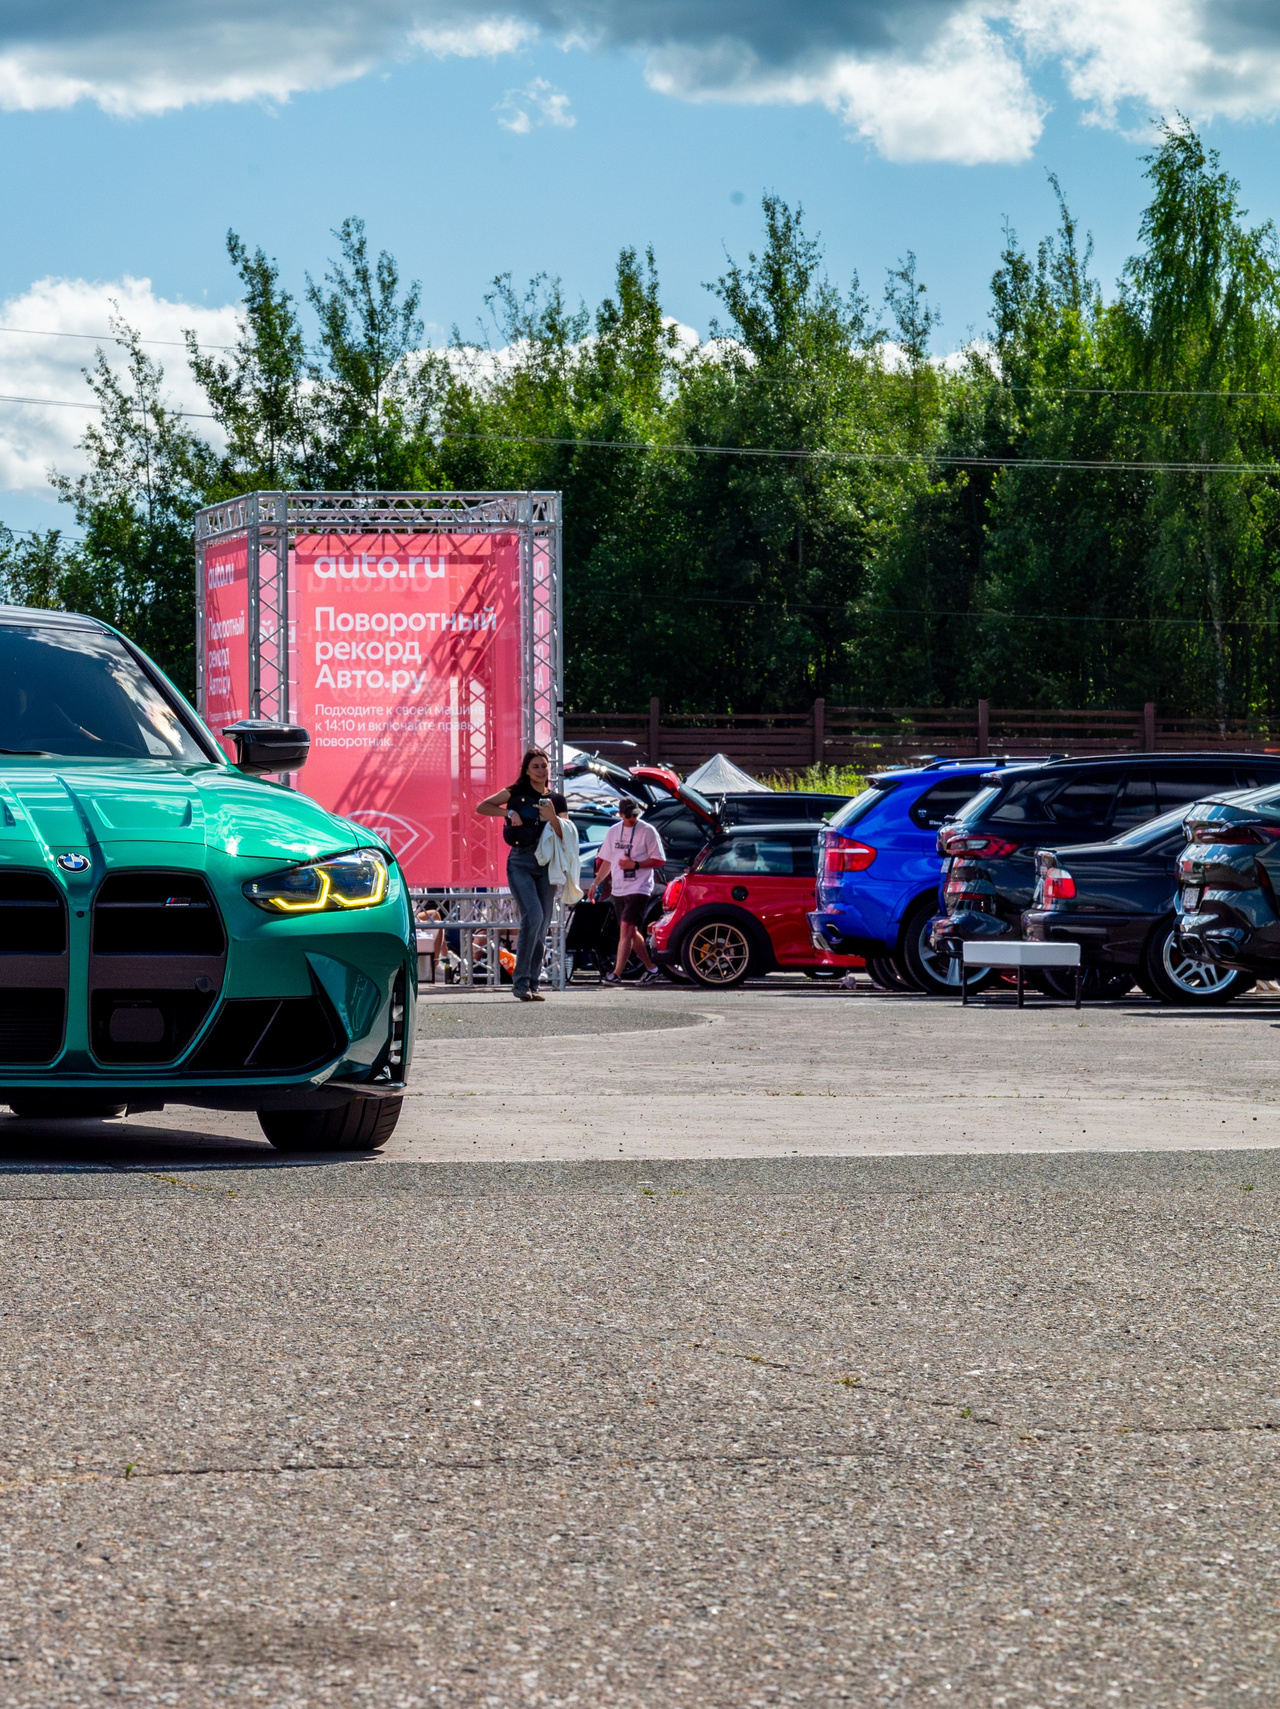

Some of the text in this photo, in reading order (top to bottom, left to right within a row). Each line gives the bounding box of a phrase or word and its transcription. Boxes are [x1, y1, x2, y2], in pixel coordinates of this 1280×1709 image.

[207, 562, 235, 590] auto.ru
[314, 552, 445, 578] auto.ru
[208, 610, 245, 644] Поворотный
[314, 606, 496, 637] Поворотный
[315, 641, 422, 665] рекорд
[314, 664, 426, 694] Авто.ру
[315, 703, 485, 717] Подходите к своей машине
[315, 722, 321, 731] к
[325, 720, 354, 731] 14:10
[358, 722, 365, 731] и
[368, 720, 435, 732] включайте
